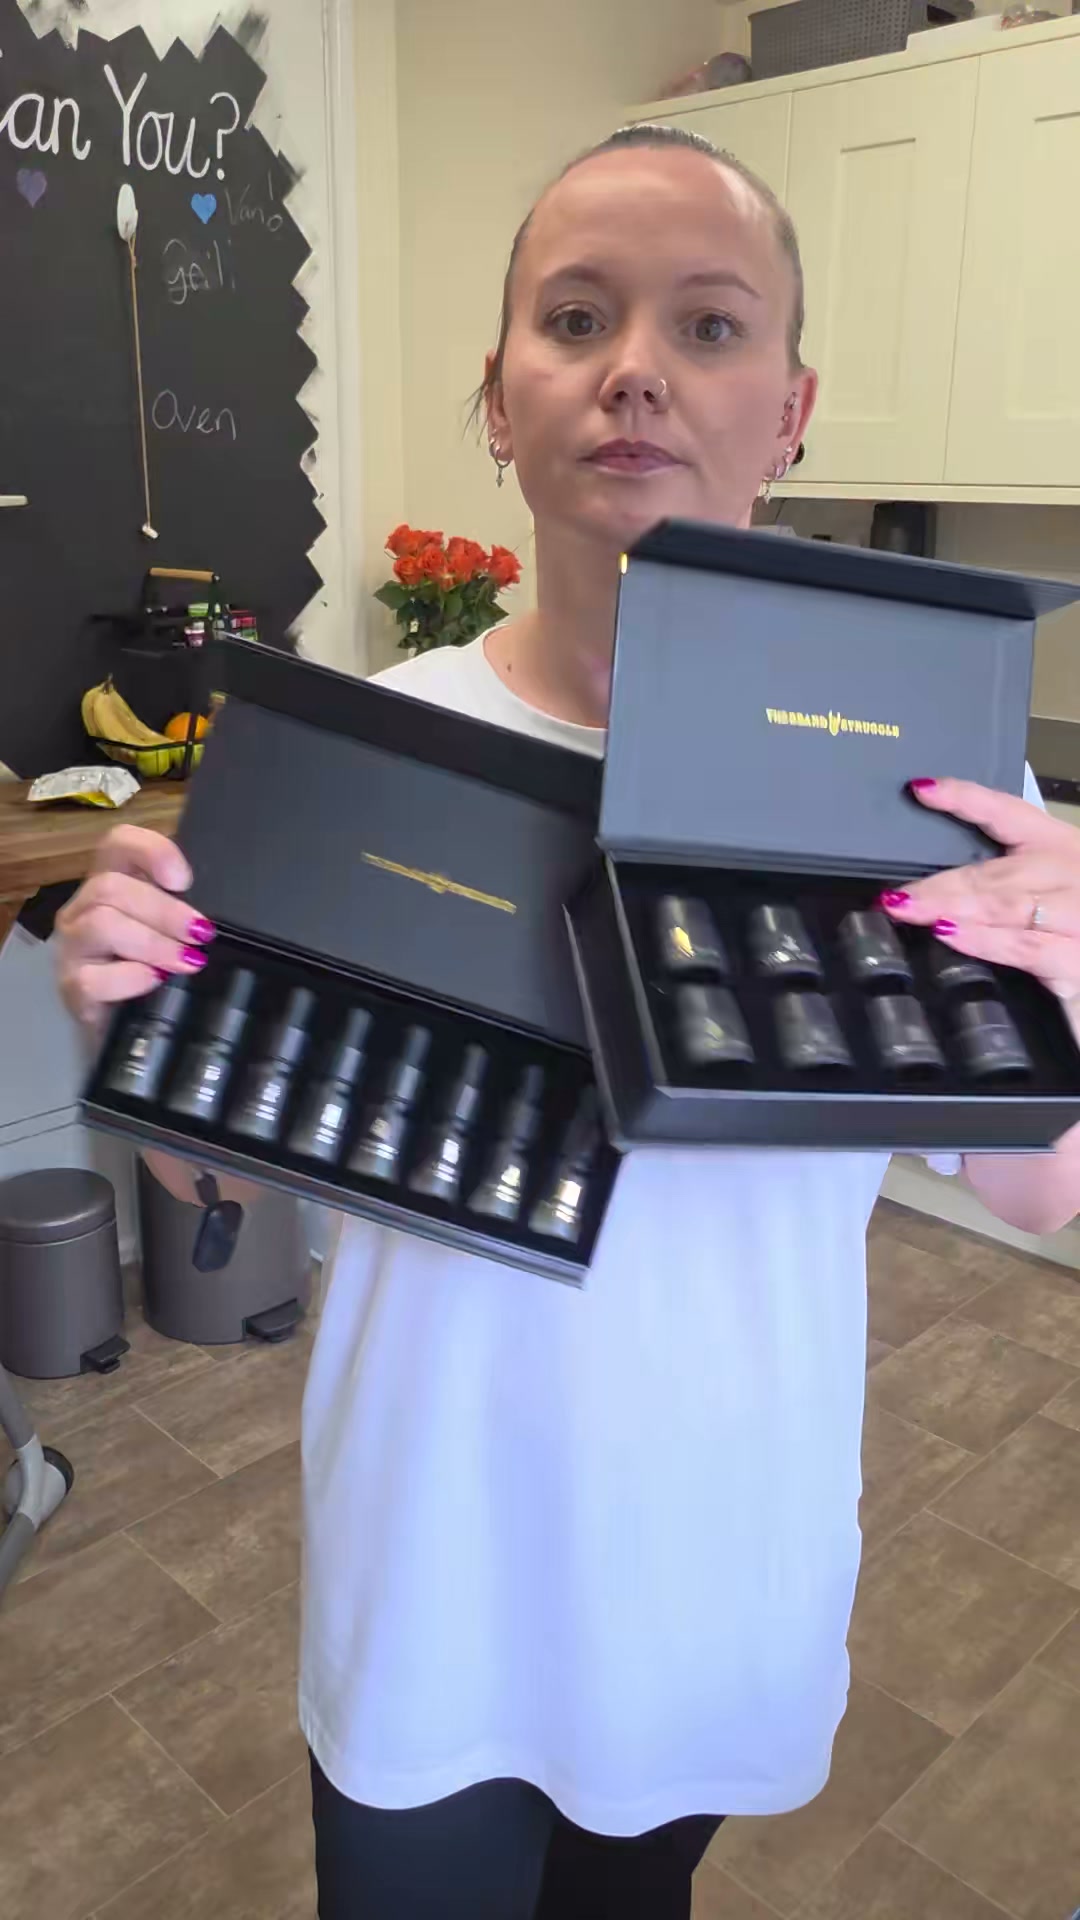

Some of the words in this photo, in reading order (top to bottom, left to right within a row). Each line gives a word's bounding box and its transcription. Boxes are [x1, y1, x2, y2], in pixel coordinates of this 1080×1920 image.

[0, 92, 92, 161] an
[103, 63, 240, 181] You?
[151, 387, 237, 441] Oven
